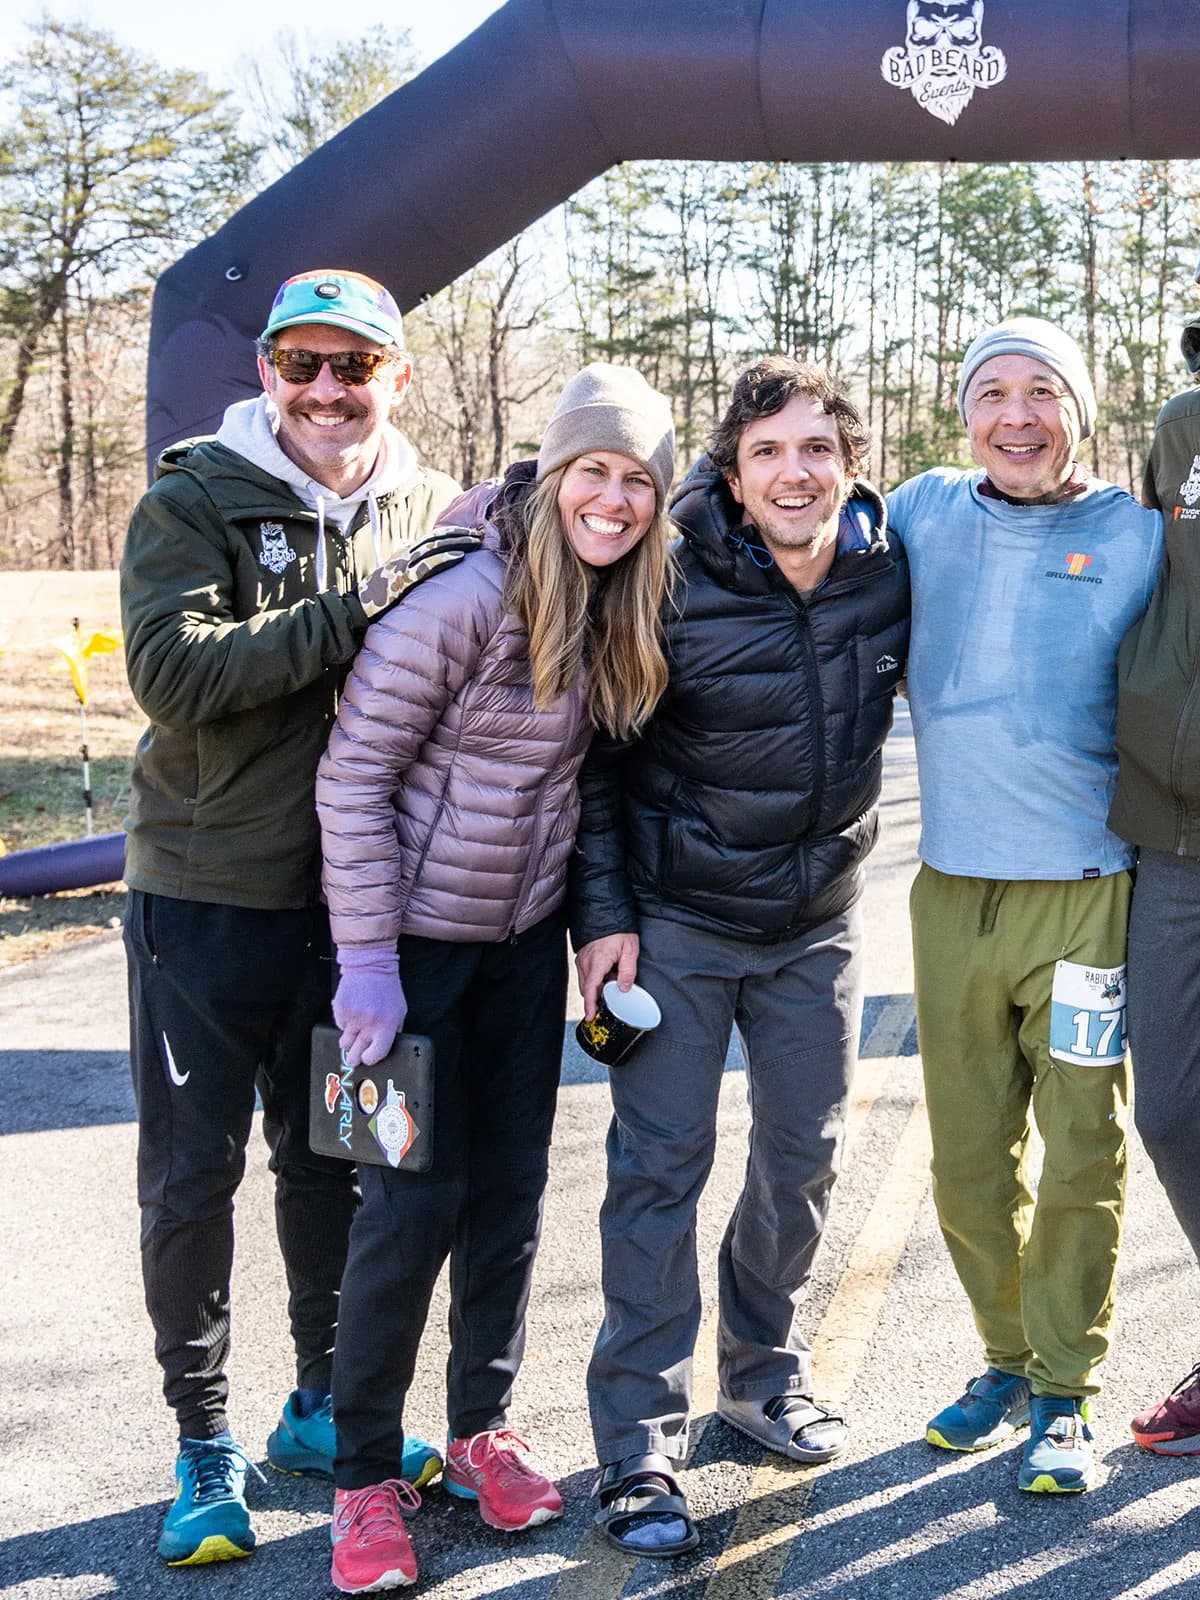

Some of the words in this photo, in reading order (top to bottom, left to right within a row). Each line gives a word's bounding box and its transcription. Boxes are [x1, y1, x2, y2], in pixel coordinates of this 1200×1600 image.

[889, 54, 926, 82] BAD
[931, 49, 1000, 82] BEARD
[919, 81, 970, 102] Events
[1049, 571, 1103, 584] RUNNING
